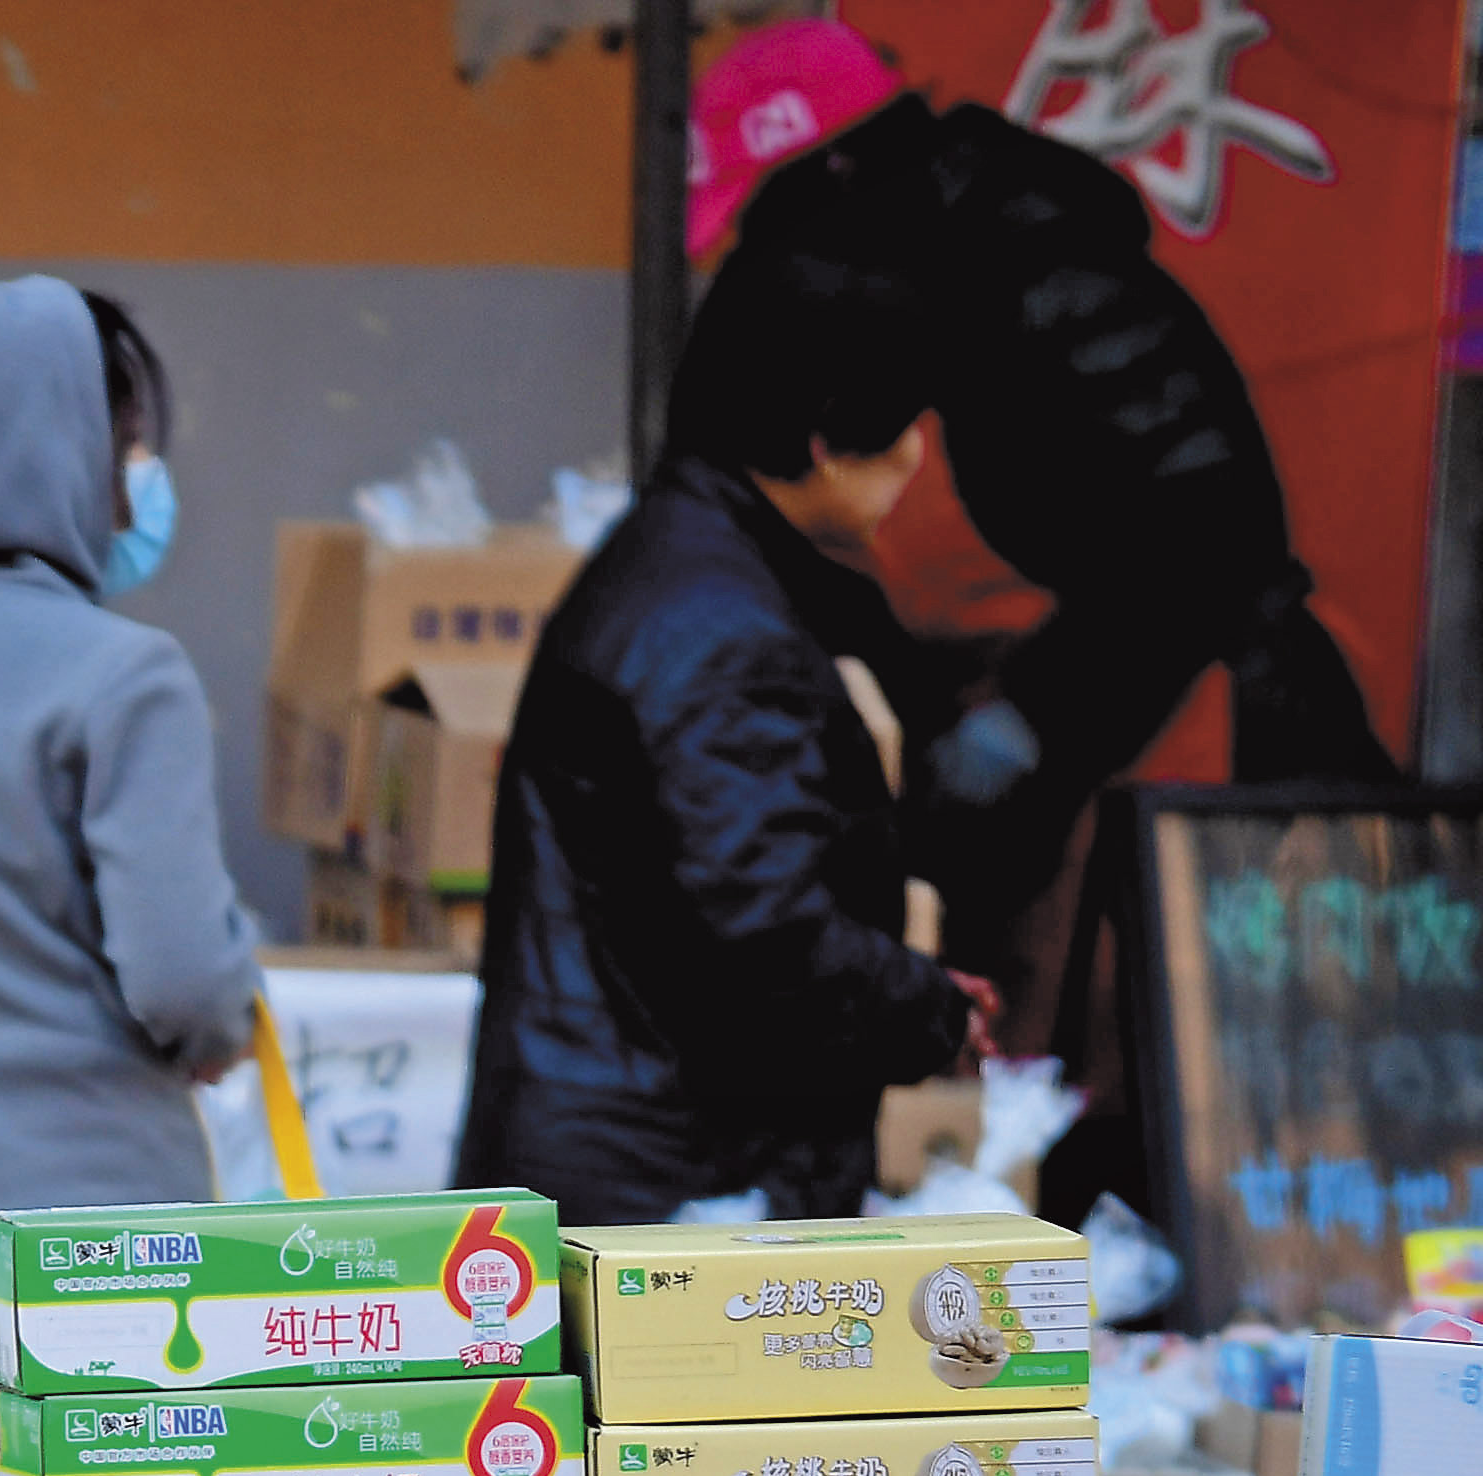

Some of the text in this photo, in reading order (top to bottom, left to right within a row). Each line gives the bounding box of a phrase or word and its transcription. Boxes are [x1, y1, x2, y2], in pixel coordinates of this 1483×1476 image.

[75, 1234, 203, 1265] 蒙牛 NBA
[314, 1237, 376, 1258] 好牛奶
[335, 1259, 398, 1279] 自然纯
[649, 1267, 695, 1292] 蒙牛
[725, 1278, 884, 1321] 核桃牛奶
[263, 1302, 402, 1358] 纯牛奶
[174, 1406, 228, 1437] NBA
[652, 1443, 698, 1468] 蒙牛
